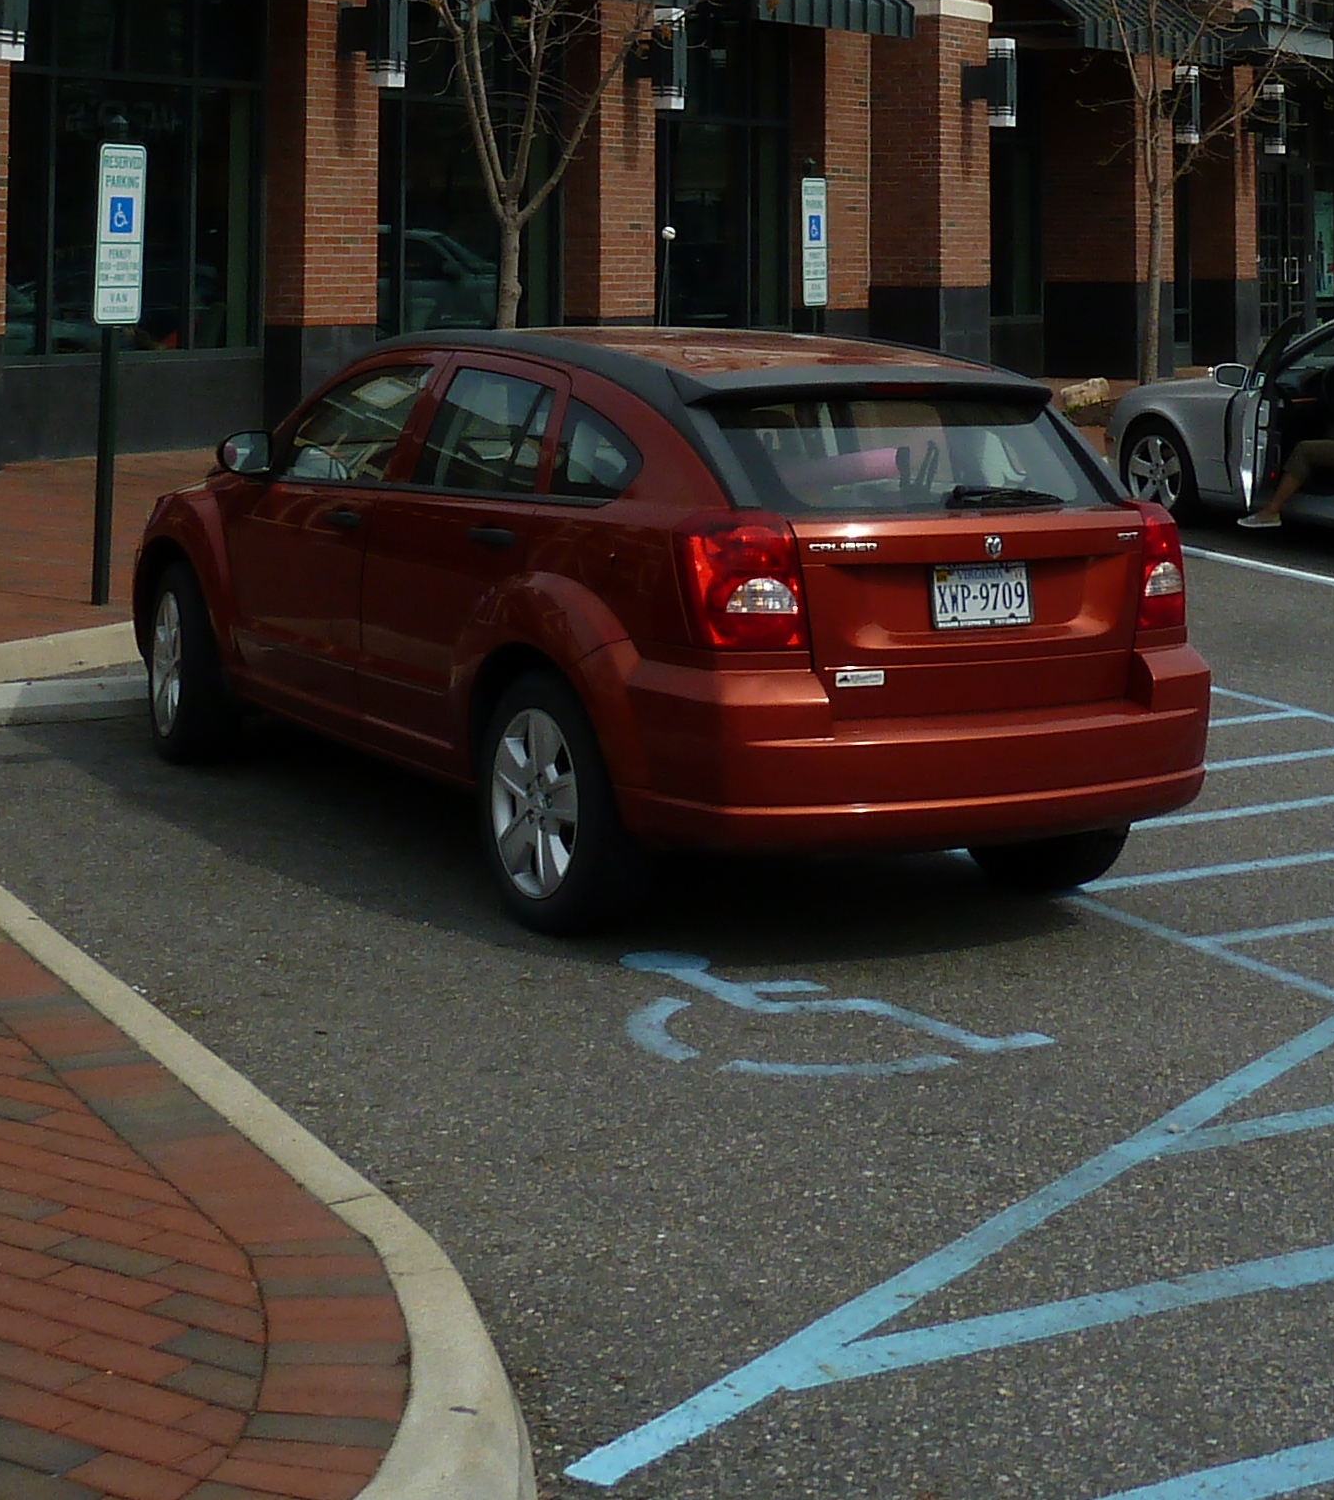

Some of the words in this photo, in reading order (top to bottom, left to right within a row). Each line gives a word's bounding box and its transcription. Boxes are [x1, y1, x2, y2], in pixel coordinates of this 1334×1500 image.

[104, 155, 142, 169] RESERVED
[106, 175, 139, 187] PARKING
[110, 293, 128, 303] VAN
[809, 542, 877, 552] CALIBER
[956, 567, 1003, 580] VIRGINIA
[936, 581, 1026, 614] XWP-9709
